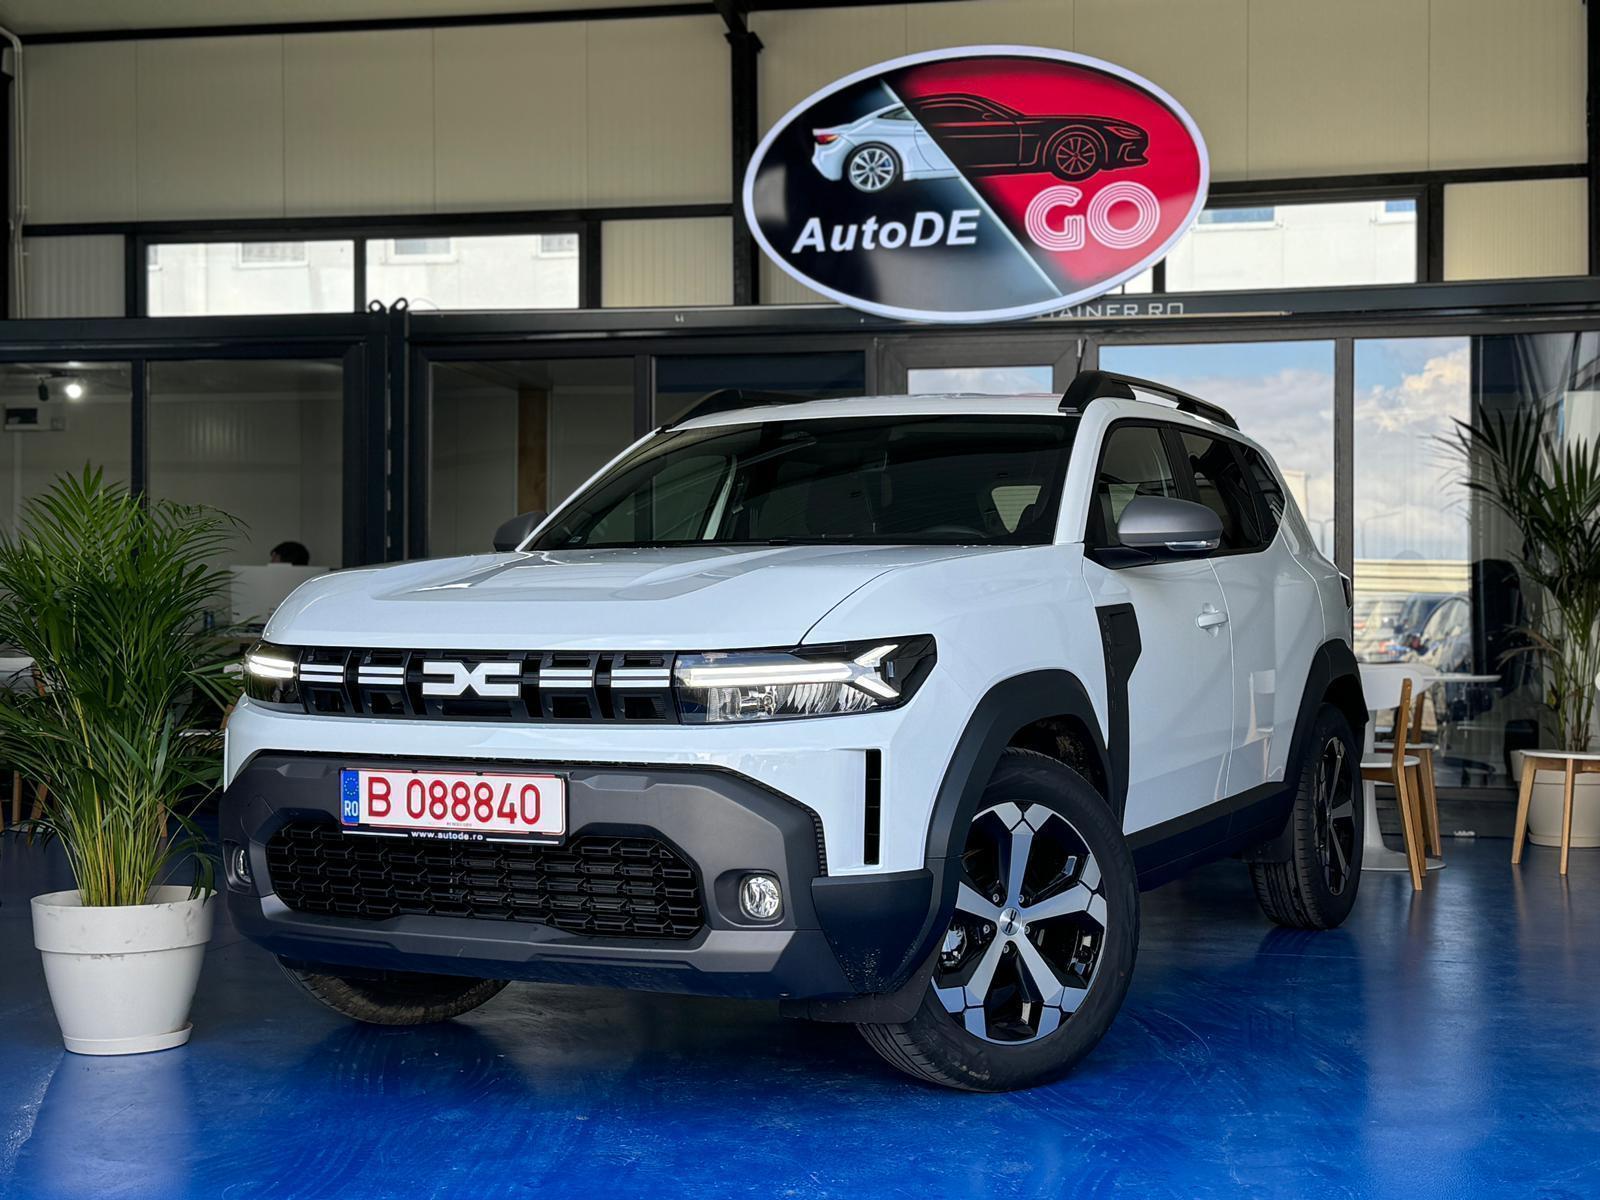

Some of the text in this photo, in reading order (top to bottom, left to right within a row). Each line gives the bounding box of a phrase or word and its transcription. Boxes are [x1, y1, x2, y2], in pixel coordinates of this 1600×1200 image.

[791, 209, 980, 254] AutoDE
[1024, 181, 1161, 251] GO
[344, 800, 359, 818] RO
[367, 776, 541, 826] B 088840
[411, 831, 484, 841] www.autode.ro
